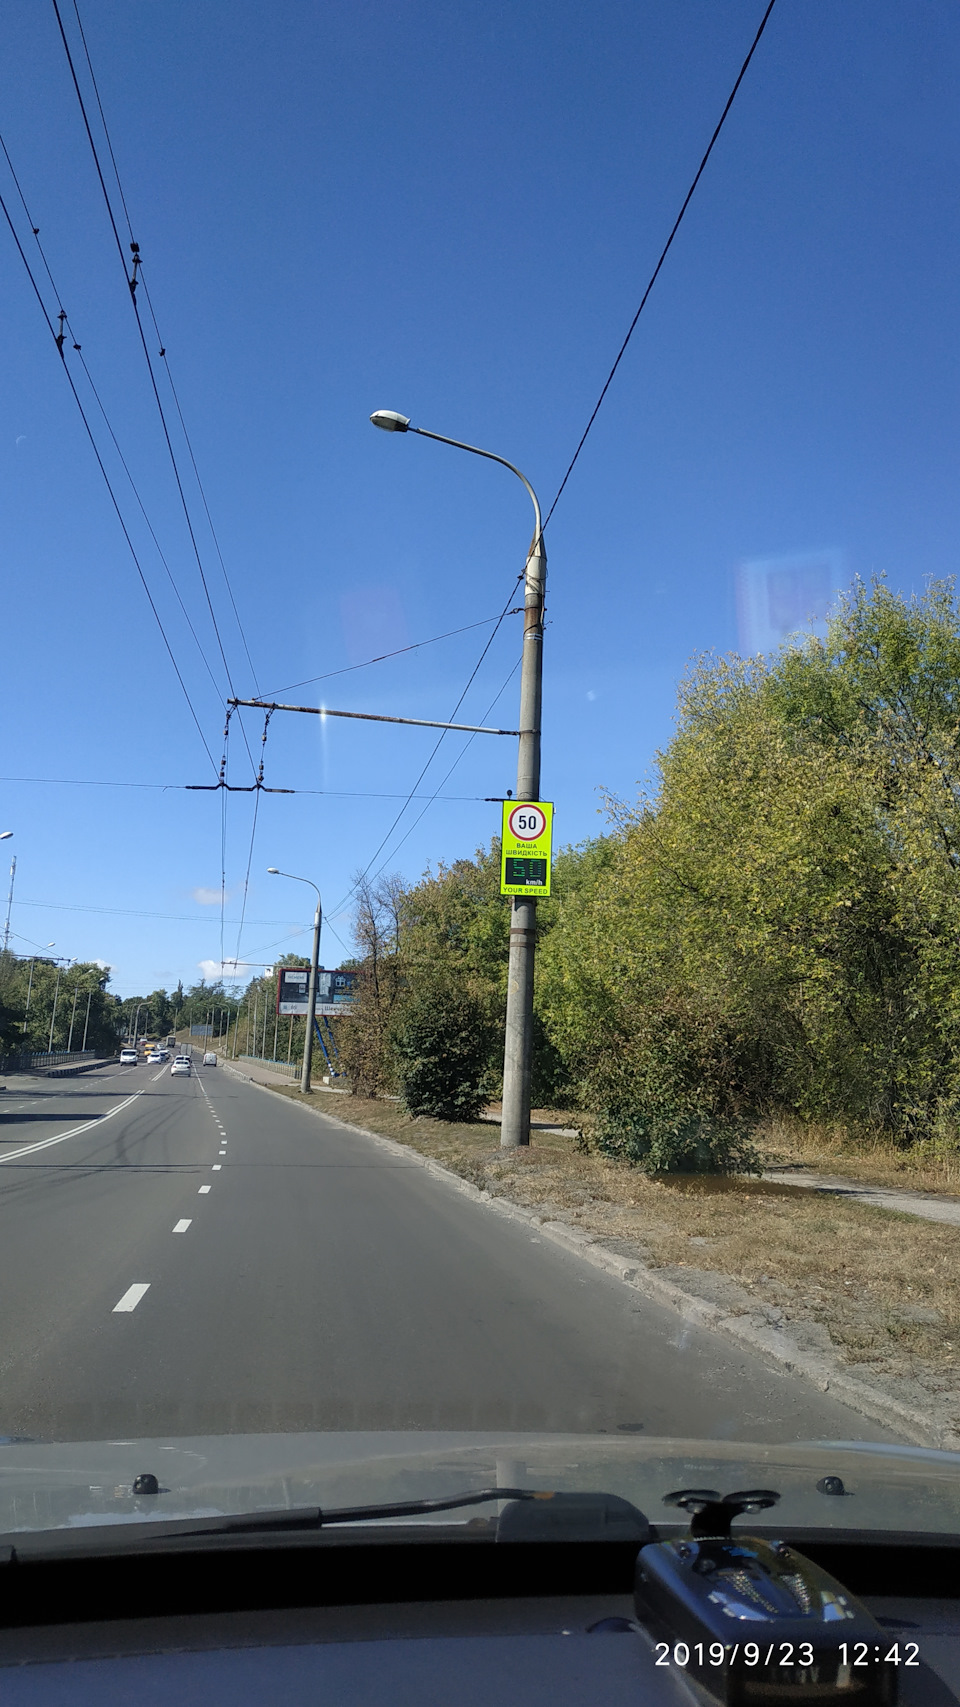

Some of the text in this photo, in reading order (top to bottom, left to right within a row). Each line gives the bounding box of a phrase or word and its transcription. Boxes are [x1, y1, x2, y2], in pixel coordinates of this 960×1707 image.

[518, 815, 537, 830] 50
[505, 849, 548, 857] ШВИДКІСТЬ
[525, 878, 543, 886] km/h
[503, 886, 548, 895] YOUR SPEED
